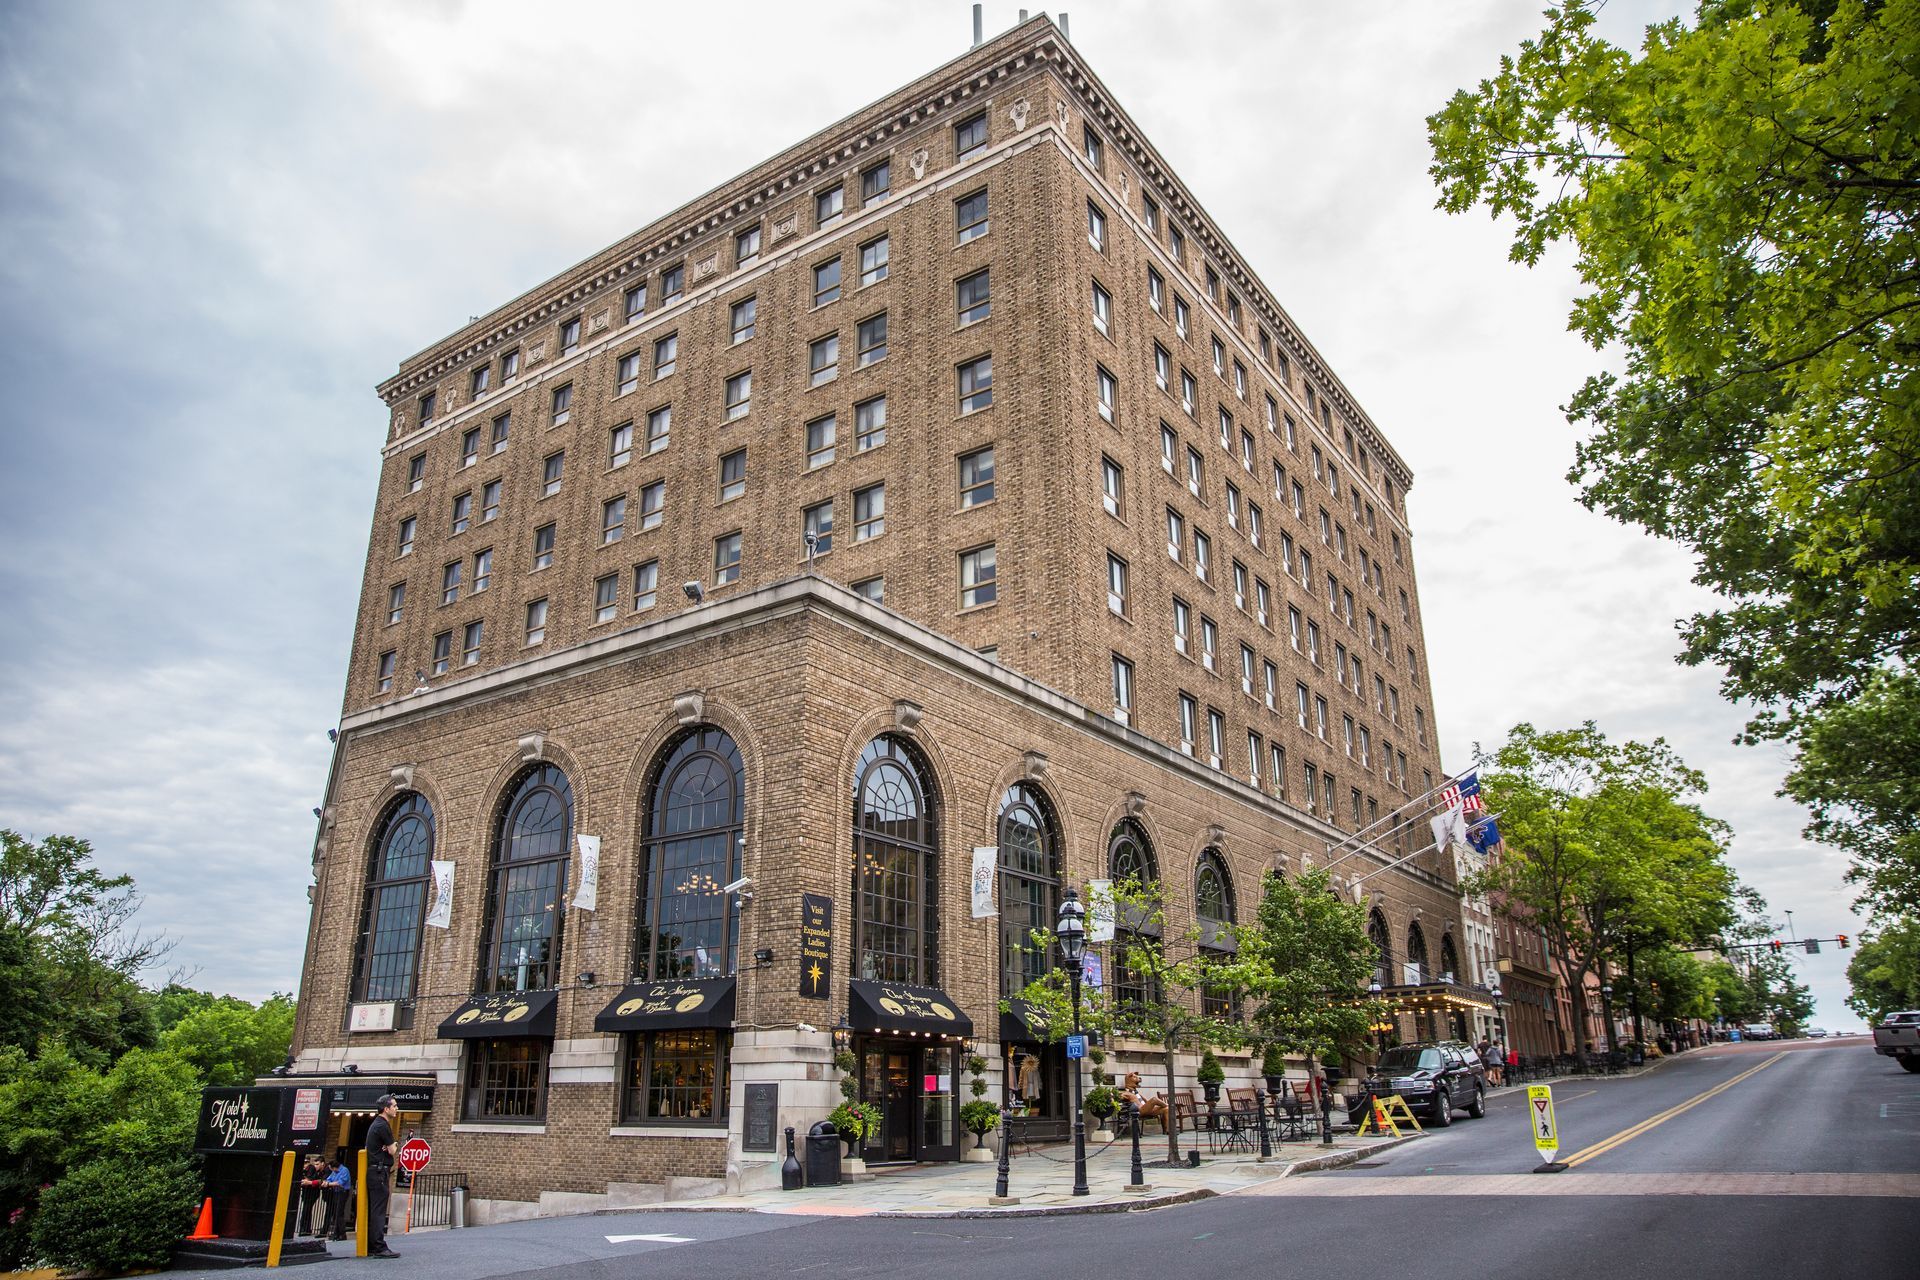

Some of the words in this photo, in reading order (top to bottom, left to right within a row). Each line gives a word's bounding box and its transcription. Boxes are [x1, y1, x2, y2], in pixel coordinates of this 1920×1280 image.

[811, 905, 824, 915] Visit
[812, 918, 823, 926] our
[803, 926, 831, 938] Expanded
[808, 937, 826, 948] Ladies
[804, 948, 829, 960] Boutique
[650, 986, 667, 996] The
[668, 984, 700, 996] Shoppe
[882, 988, 903, 999] The
[903, 990, 932, 1003] Shoppe
[486, 998, 500, 1008] The
[211, 1094, 242, 1128] Hotel
[221, 1117, 268, 1147] Bethlehem
[403, 1149, 429, 1161] STOP
